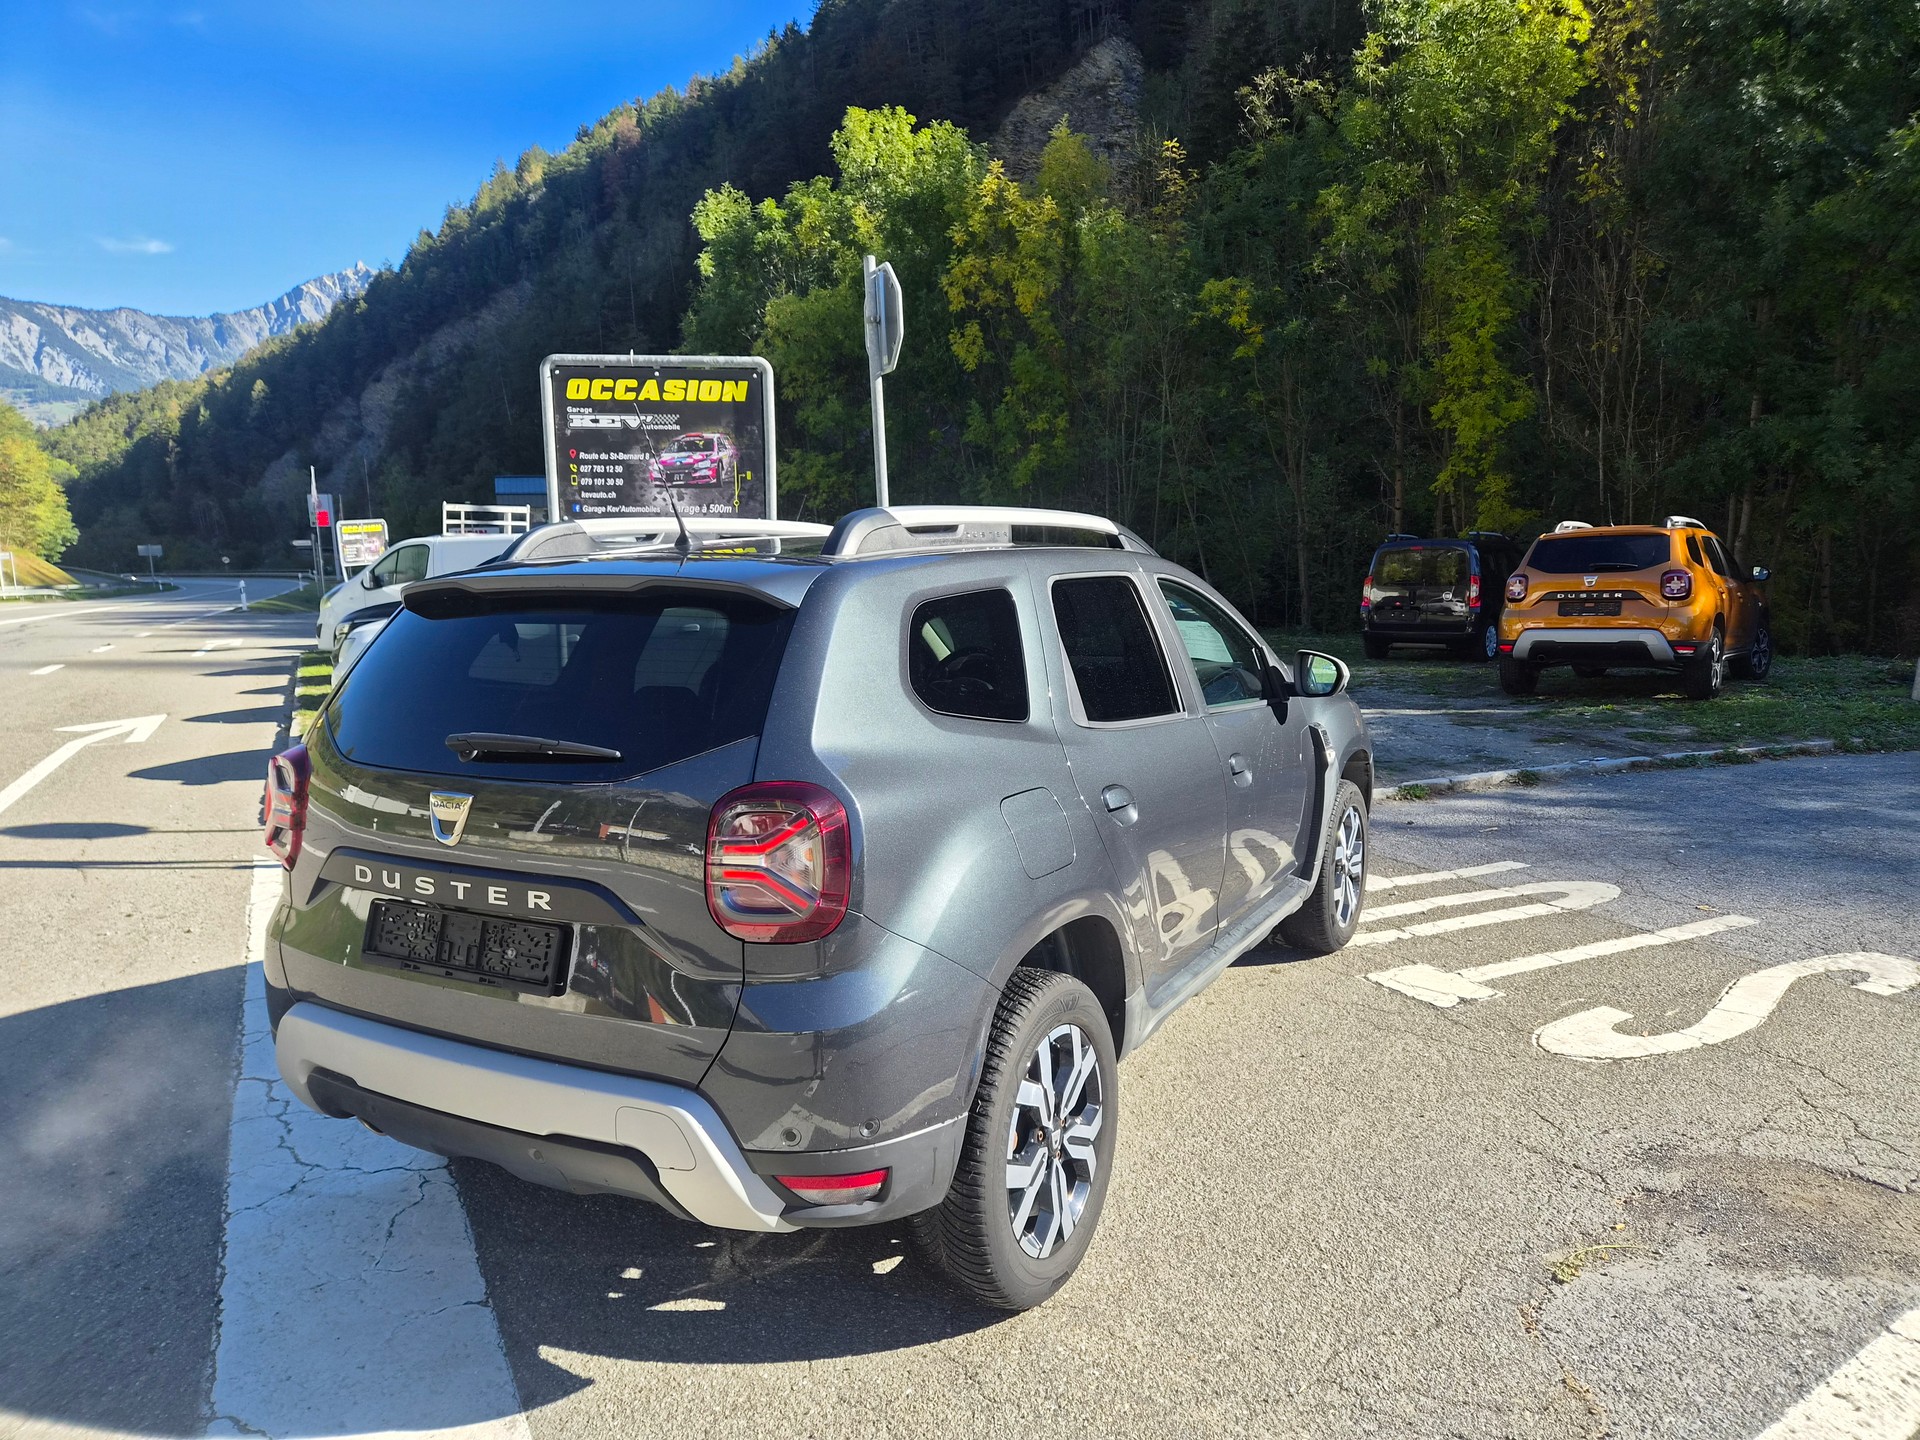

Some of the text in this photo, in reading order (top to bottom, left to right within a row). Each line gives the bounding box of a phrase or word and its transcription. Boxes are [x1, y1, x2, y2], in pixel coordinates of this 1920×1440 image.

[566, 378, 748, 402] OCCASION
[566, 406, 593, 414] Garage
[579, 452, 599, 460] Route
[600, 452, 609, 460] du
[610, 452, 644, 460] St-Bernard
[580, 465, 623, 473] 027 783 12 50
[580, 478, 624, 486] 079 101 30 50
[581, 491, 616, 499] kevauto.ch
[582, 504, 606, 514] Garage
[701, 504, 707, 513] à
[709, 504, 732, 513] 500m
[433, 800, 461, 810] DACIA
[355, 864, 552, 910] DUSTER
